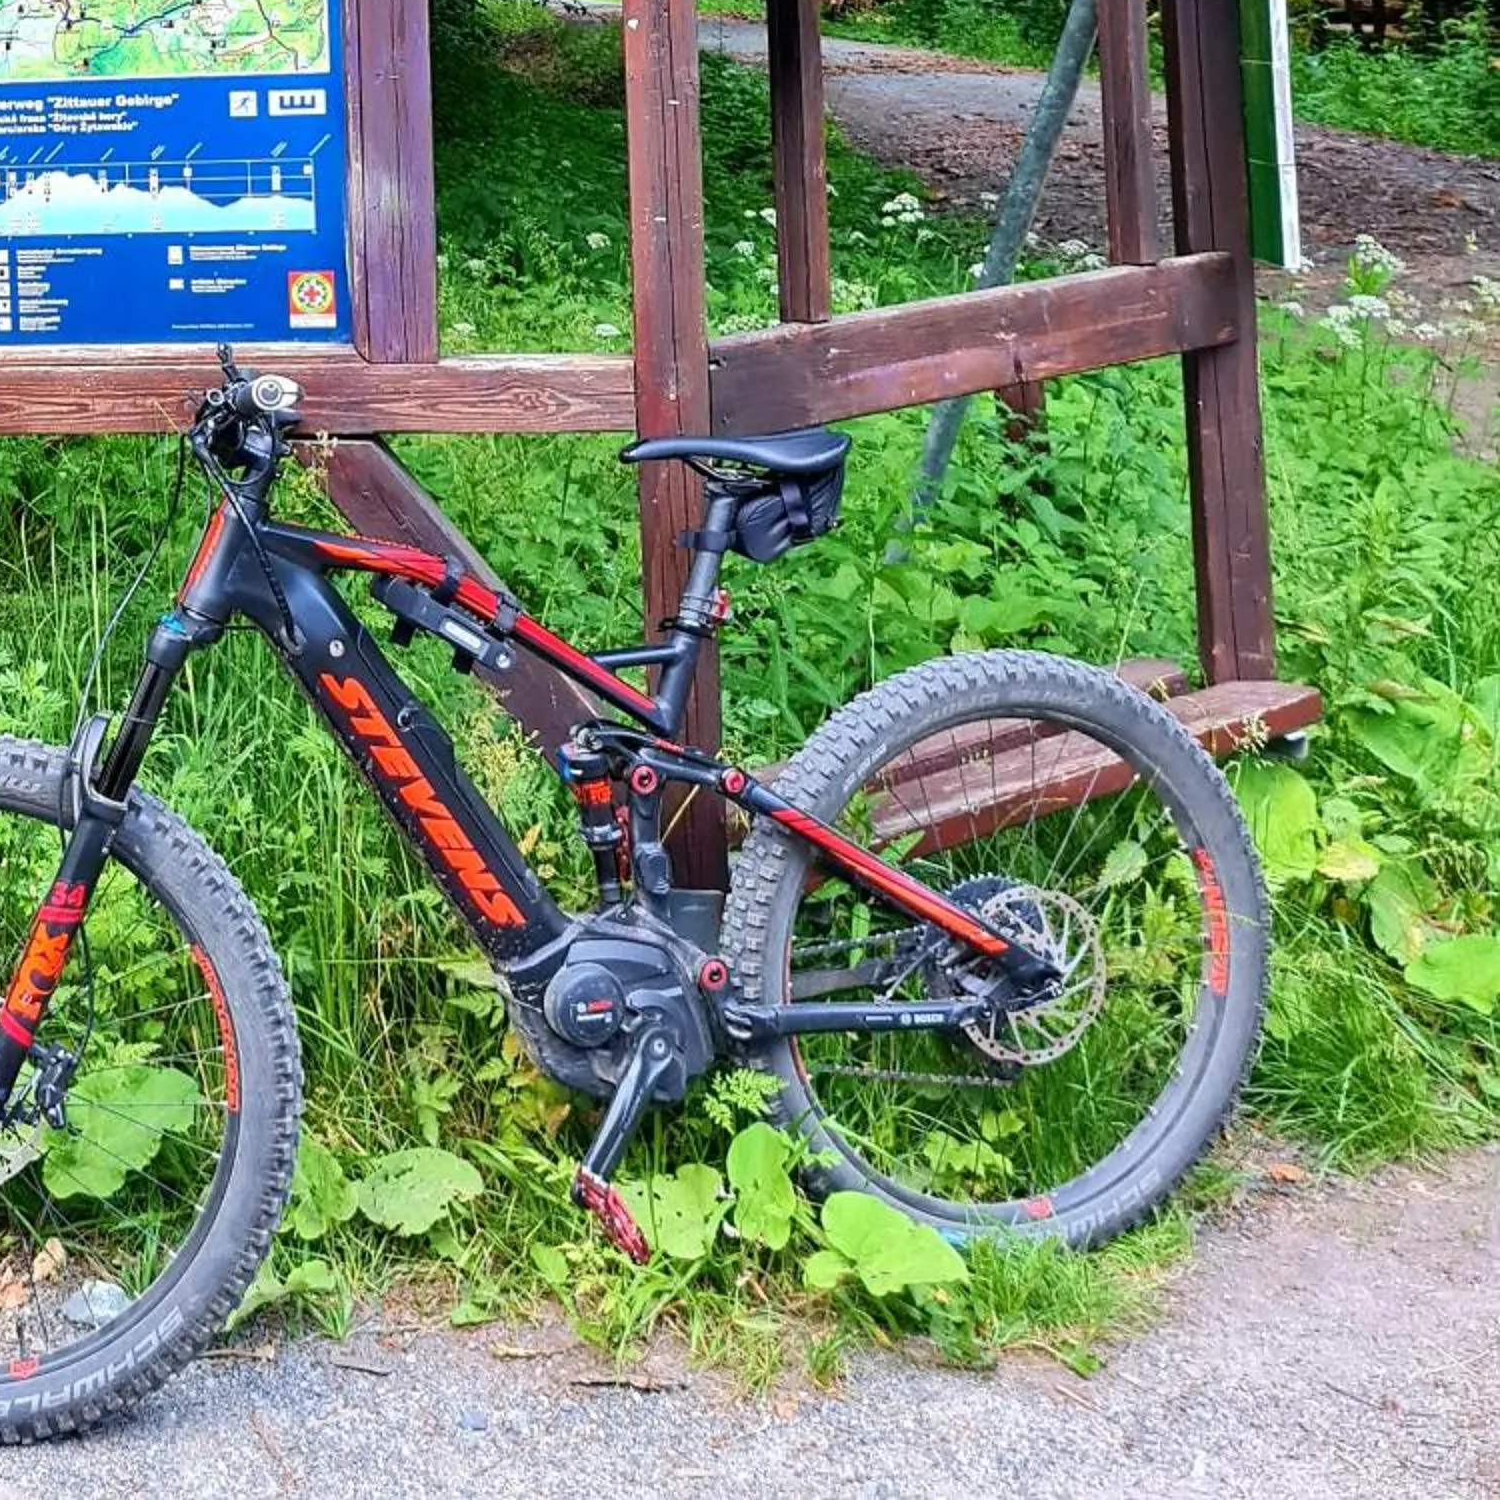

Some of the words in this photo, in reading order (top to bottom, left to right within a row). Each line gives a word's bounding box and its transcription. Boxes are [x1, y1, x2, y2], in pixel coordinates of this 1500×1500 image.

[320, 672, 528, 928] STEVENS
[51, 880, 86, 908] 34
[7, 917, 70, 1023] FOX
